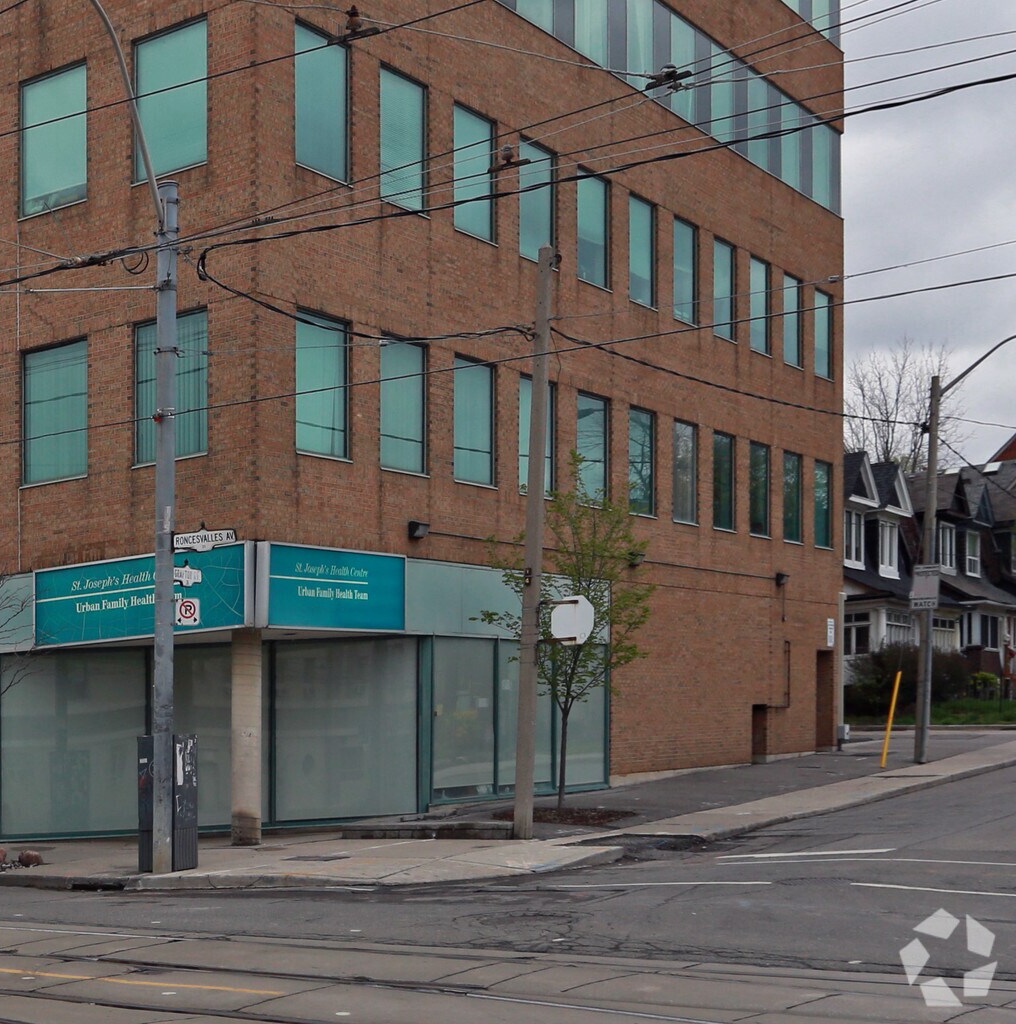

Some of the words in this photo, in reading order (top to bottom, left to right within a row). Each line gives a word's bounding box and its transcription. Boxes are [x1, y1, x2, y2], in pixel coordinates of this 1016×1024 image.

[175, 533, 224, 546] RONCESVALLES
[226, 532, 234, 541] AV
[304, 563, 330, 576] Joseph's
[330, 565, 349, 576] Health
[350, 566, 369, 578] Centre
[71, 580, 82, 592] St.
[83, 576, 120, 590] Joseph's
[121, 570, 152, 585] Health
[297, 586, 316, 597] Urban
[316, 587, 335, 601] Family
[335, 588, 353, 599] Health
[353, 589, 369, 600] Team
[76, 602, 100, 613] Urban
[102, 596, 129, 610] Family
